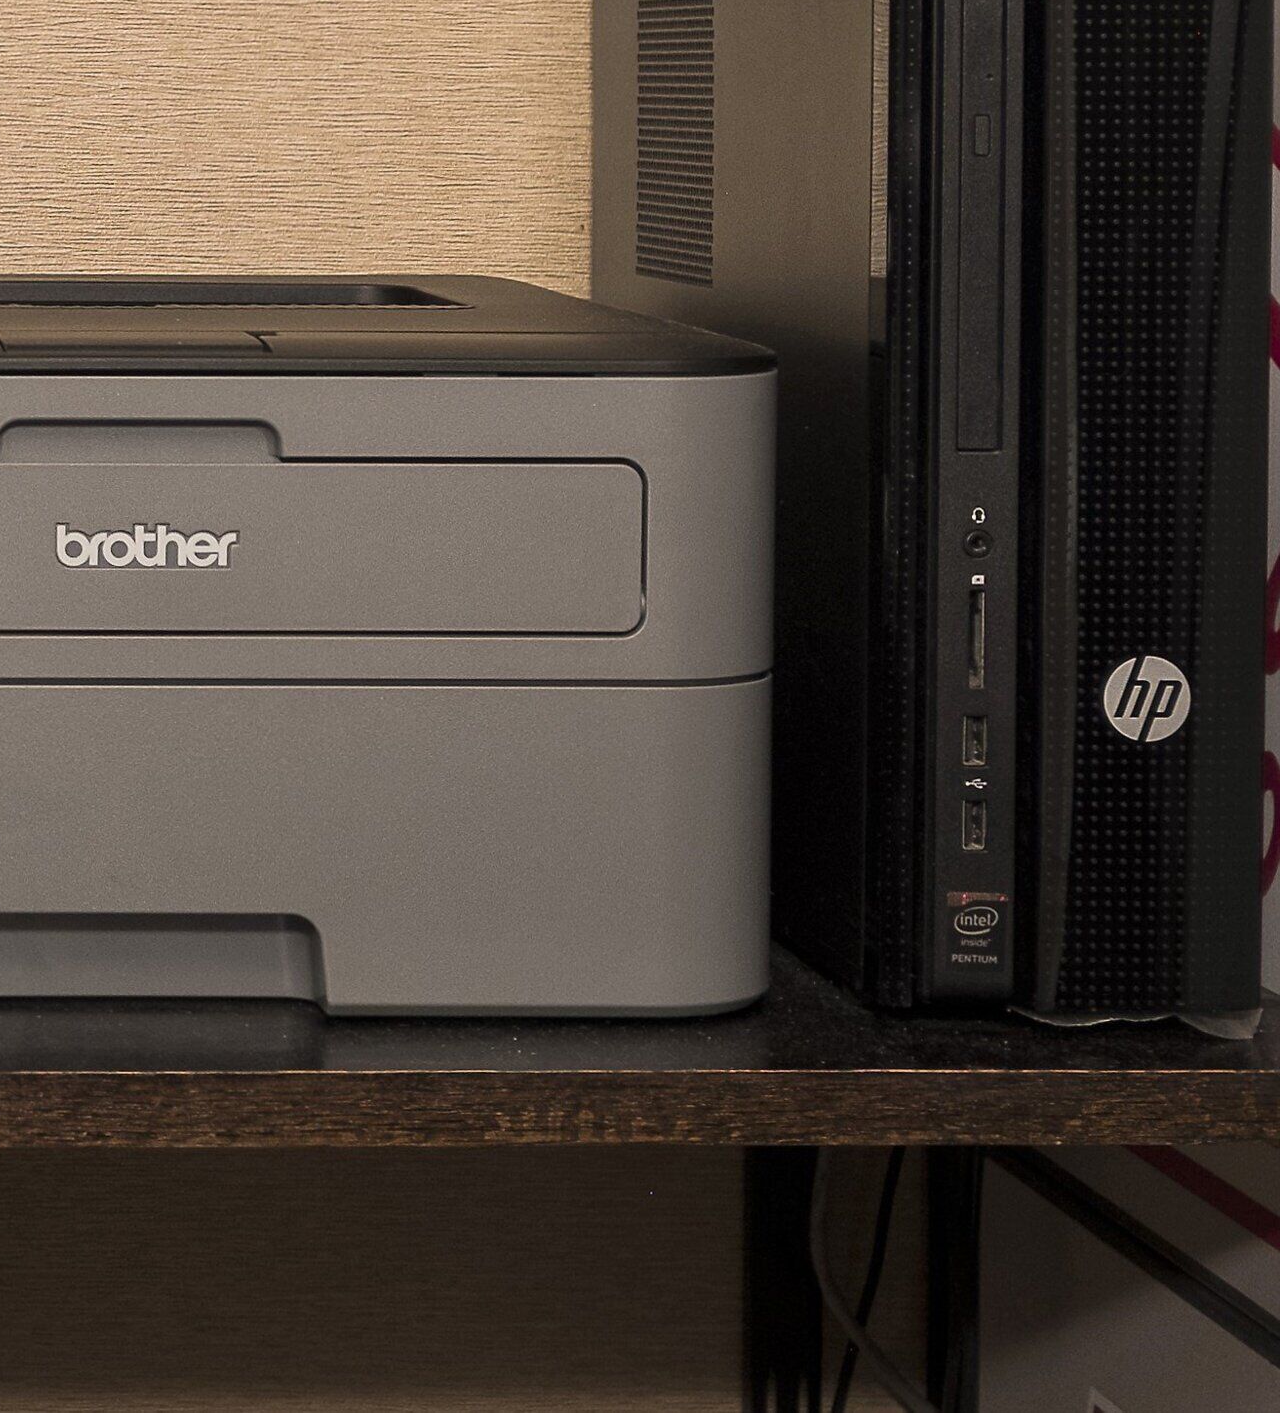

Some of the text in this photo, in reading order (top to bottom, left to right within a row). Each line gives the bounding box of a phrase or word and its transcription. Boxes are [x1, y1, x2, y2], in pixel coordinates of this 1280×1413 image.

[56, 524, 237, 567] brother
[1112, 655, 1184, 742] hp
[951, 954, 998, 963] PENTIUM
